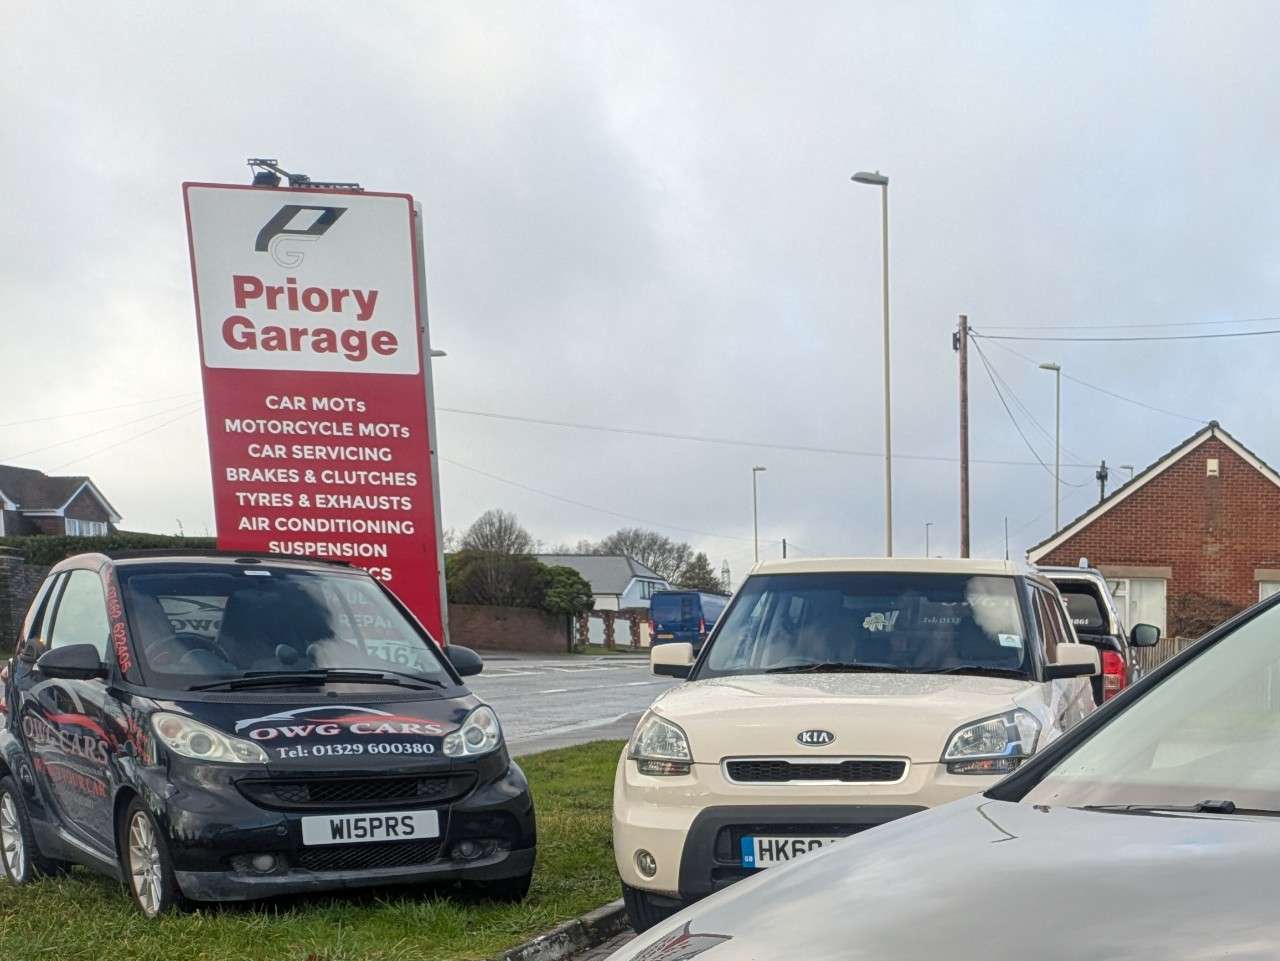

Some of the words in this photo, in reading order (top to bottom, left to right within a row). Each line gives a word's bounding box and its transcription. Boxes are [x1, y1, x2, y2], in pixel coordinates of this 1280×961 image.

[232, 275, 379, 321] Priory
[221, 315, 398, 362] Garage
[265, 395, 307, 410] CAR
[312, 397, 367, 412] MOTs
[224, 418, 354, 436] MOTORCYCLE
[358, 423, 410, 438] MOTs
[247, 443, 288, 458] CAR
[292, 445, 392, 461] SERVICING
[226, 468, 300, 483] BRAKES
[304, 469, 317, 483] &
[321, 470, 417, 486] CLUTCHES
[235, 492, 293, 507] TYRES
[299, 494, 311, 508] &
[315, 494, 412, 510] EXHAUSTS
[238, 516, 271, 531] AIR
[274, 517, 415, 534] CONDITIONING
[268, 541, 388, 557] SUSPENSION
[249, 724, 343, 740] OWG
[350, 722, 444, 738] CARS
[803, 732, 829, 742] KIA
[60, 730, 109, 766] CARS
[276, 744, 308, 759] Tel:
[312, 743, 364, 757] 01329
[367, 743, 435, 755] 600380
